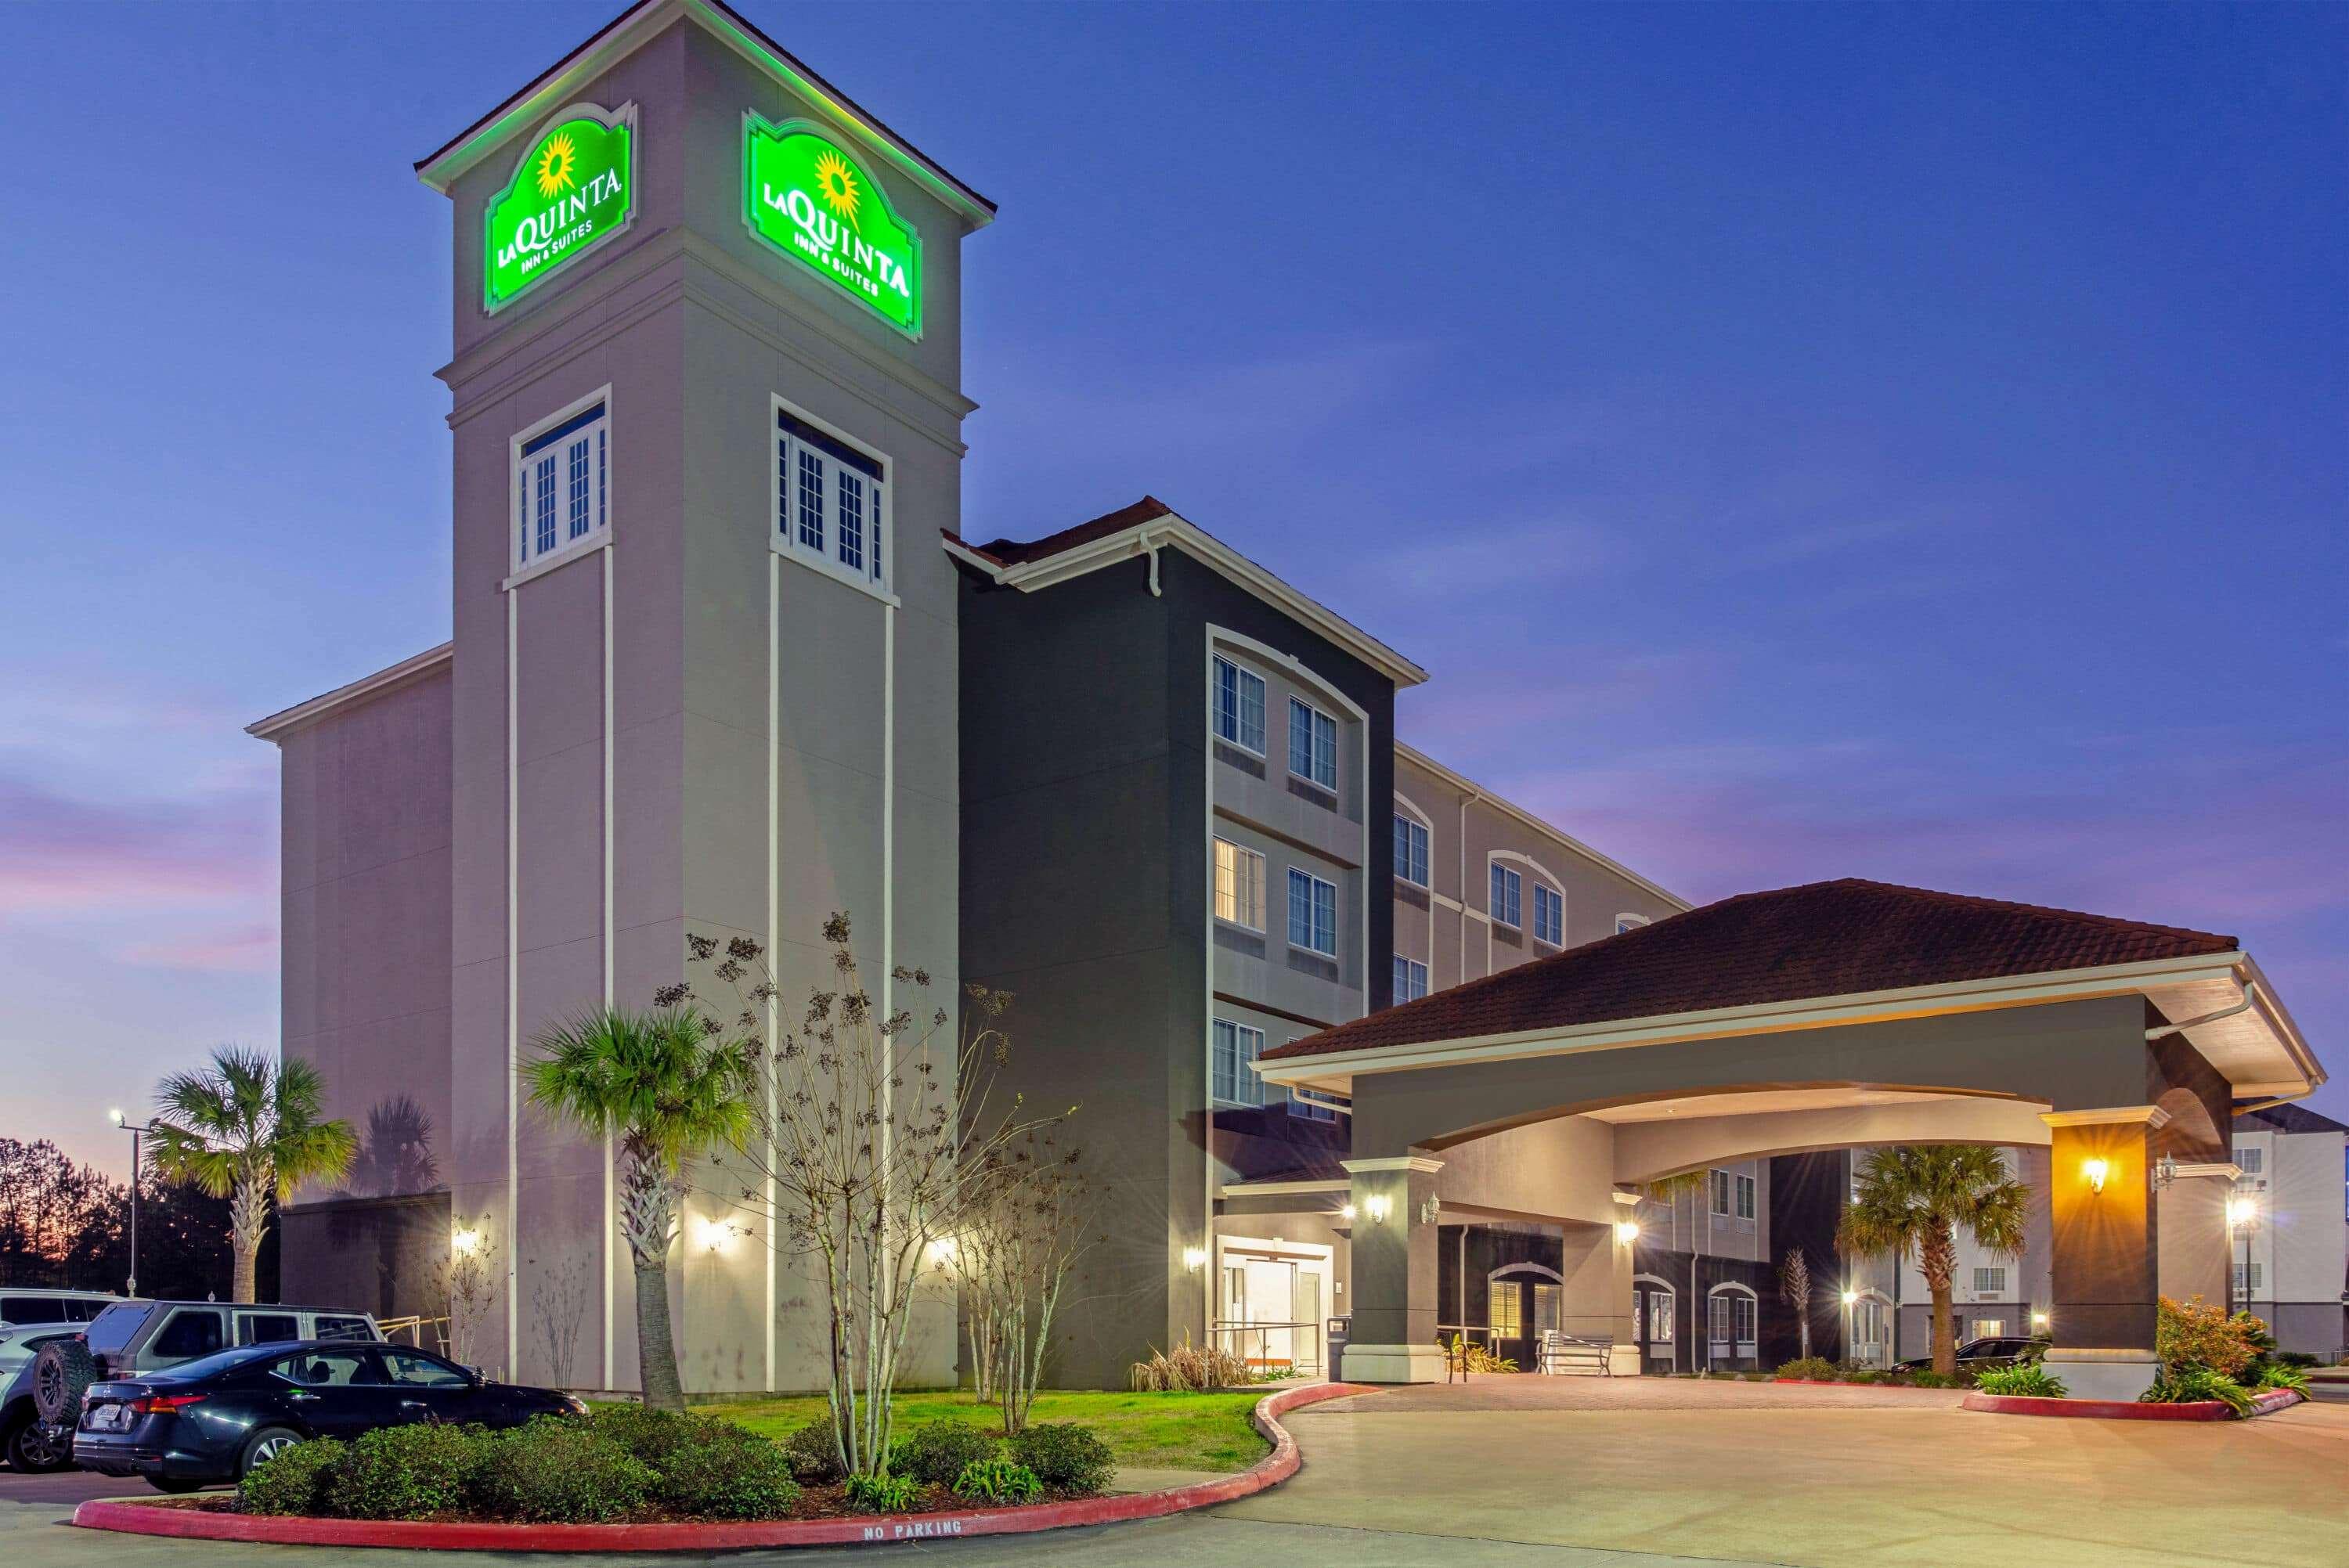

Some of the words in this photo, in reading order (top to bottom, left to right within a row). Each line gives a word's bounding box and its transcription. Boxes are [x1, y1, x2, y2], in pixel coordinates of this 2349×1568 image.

[498, 243, 518, 269] LA
[514, 167, 622, 254] QUINTA
[521, 251, 541, 275] INN
[551, 219, 593, 254] SUITES
[763, 182, 789, 216] LA
[786, 189, 910, 298] QUINTA
[794, 231, 819, 258] INN
[832, 256, 879, 297] SUITES
[864, 1527, 884, 1541] NO
[895, 1521, 962, 1537] PARKING
